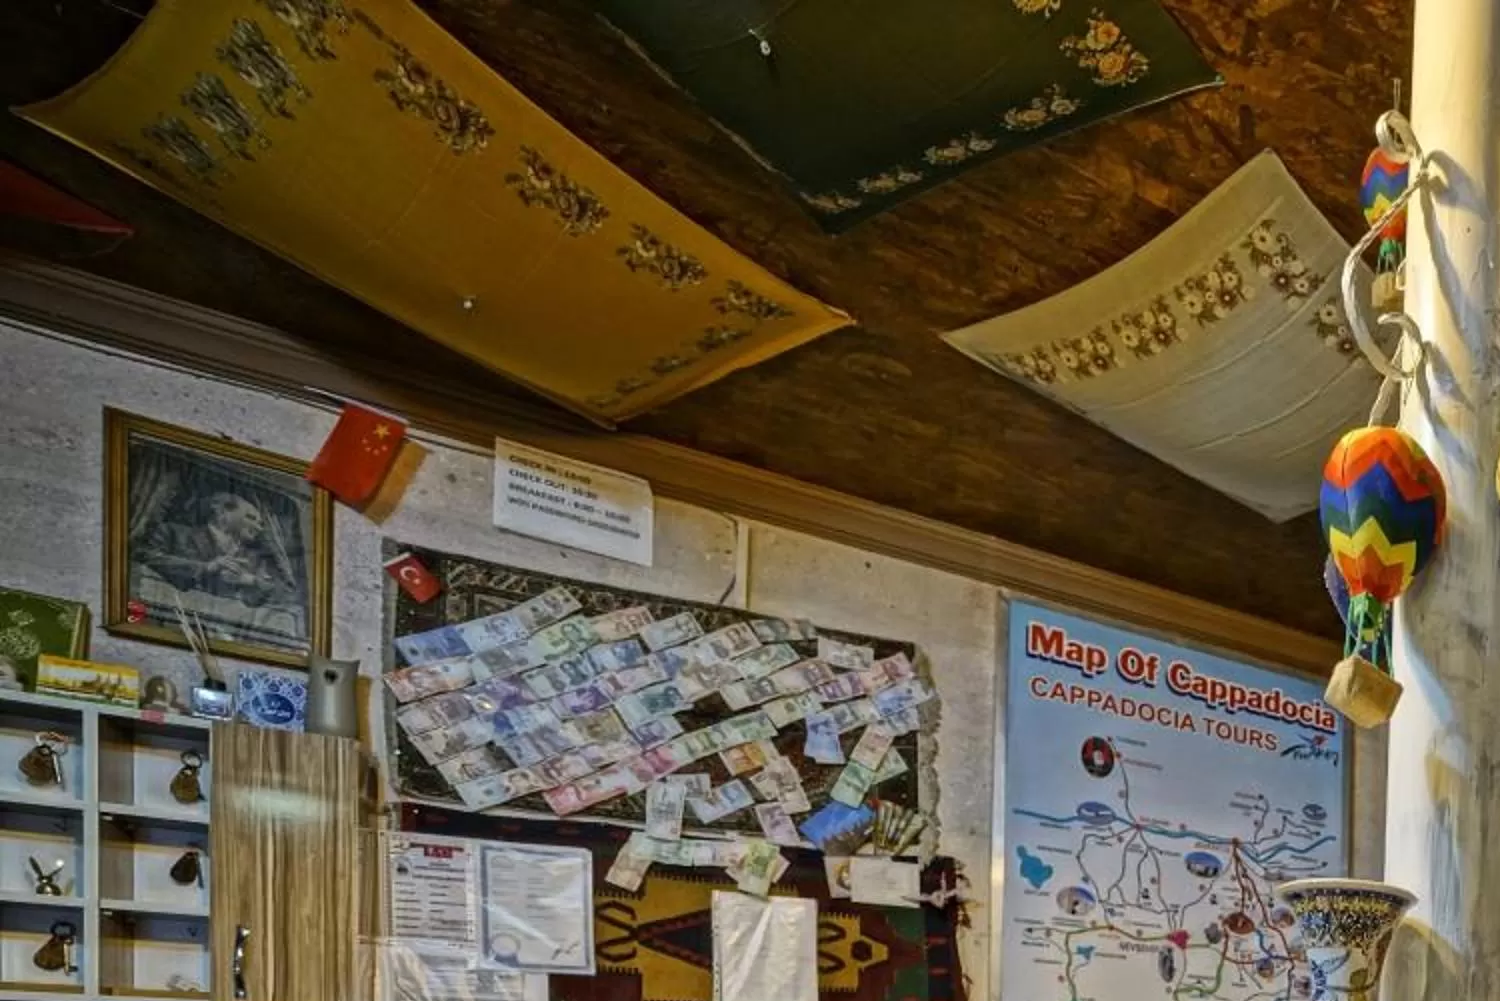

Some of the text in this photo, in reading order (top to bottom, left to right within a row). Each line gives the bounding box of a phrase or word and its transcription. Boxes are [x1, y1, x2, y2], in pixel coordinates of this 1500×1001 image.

[1026, 622, 1338, 735] Map Of Cappadocia
[1029, 676, 1279, 751] CAPPADOCIA TOURS
